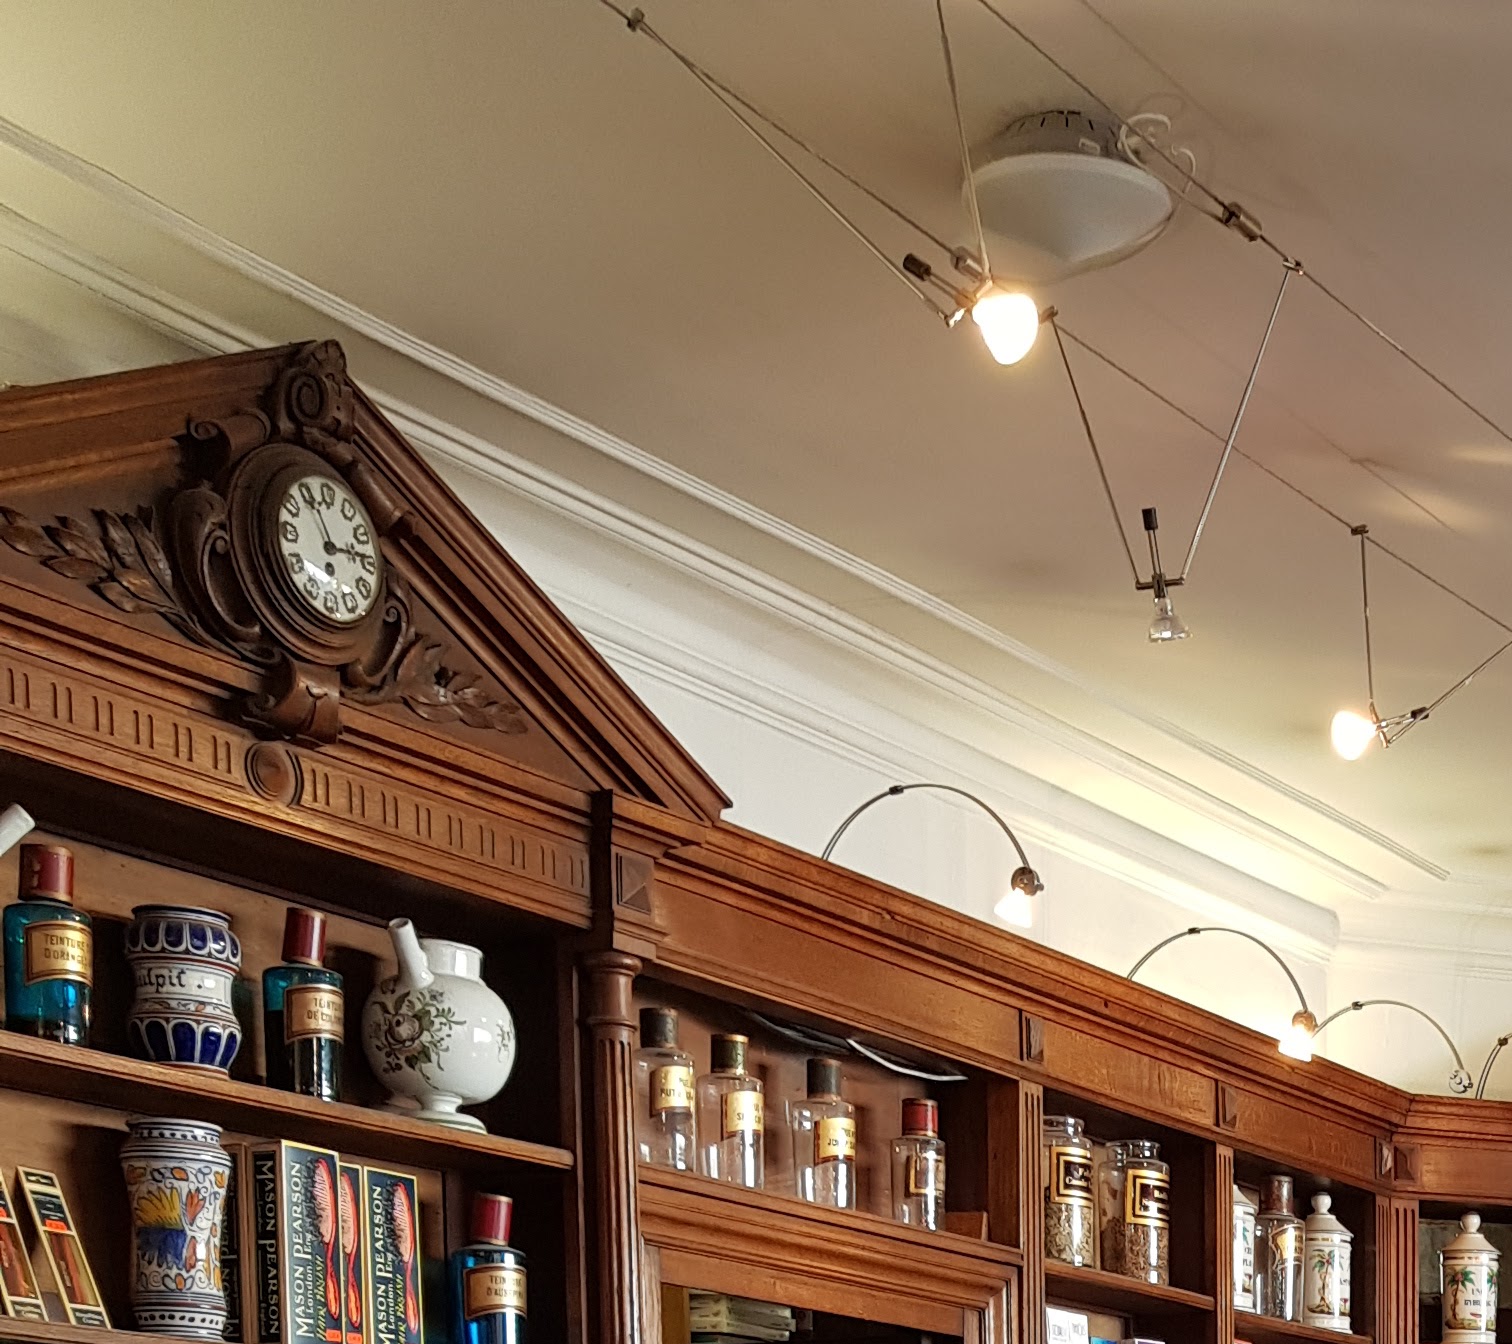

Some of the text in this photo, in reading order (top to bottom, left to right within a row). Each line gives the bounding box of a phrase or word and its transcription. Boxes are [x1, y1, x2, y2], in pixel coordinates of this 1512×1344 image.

[290, 1160, 315, 1338] MASON PEARSON
[372, 1185, 389, 1277] PEARSON
